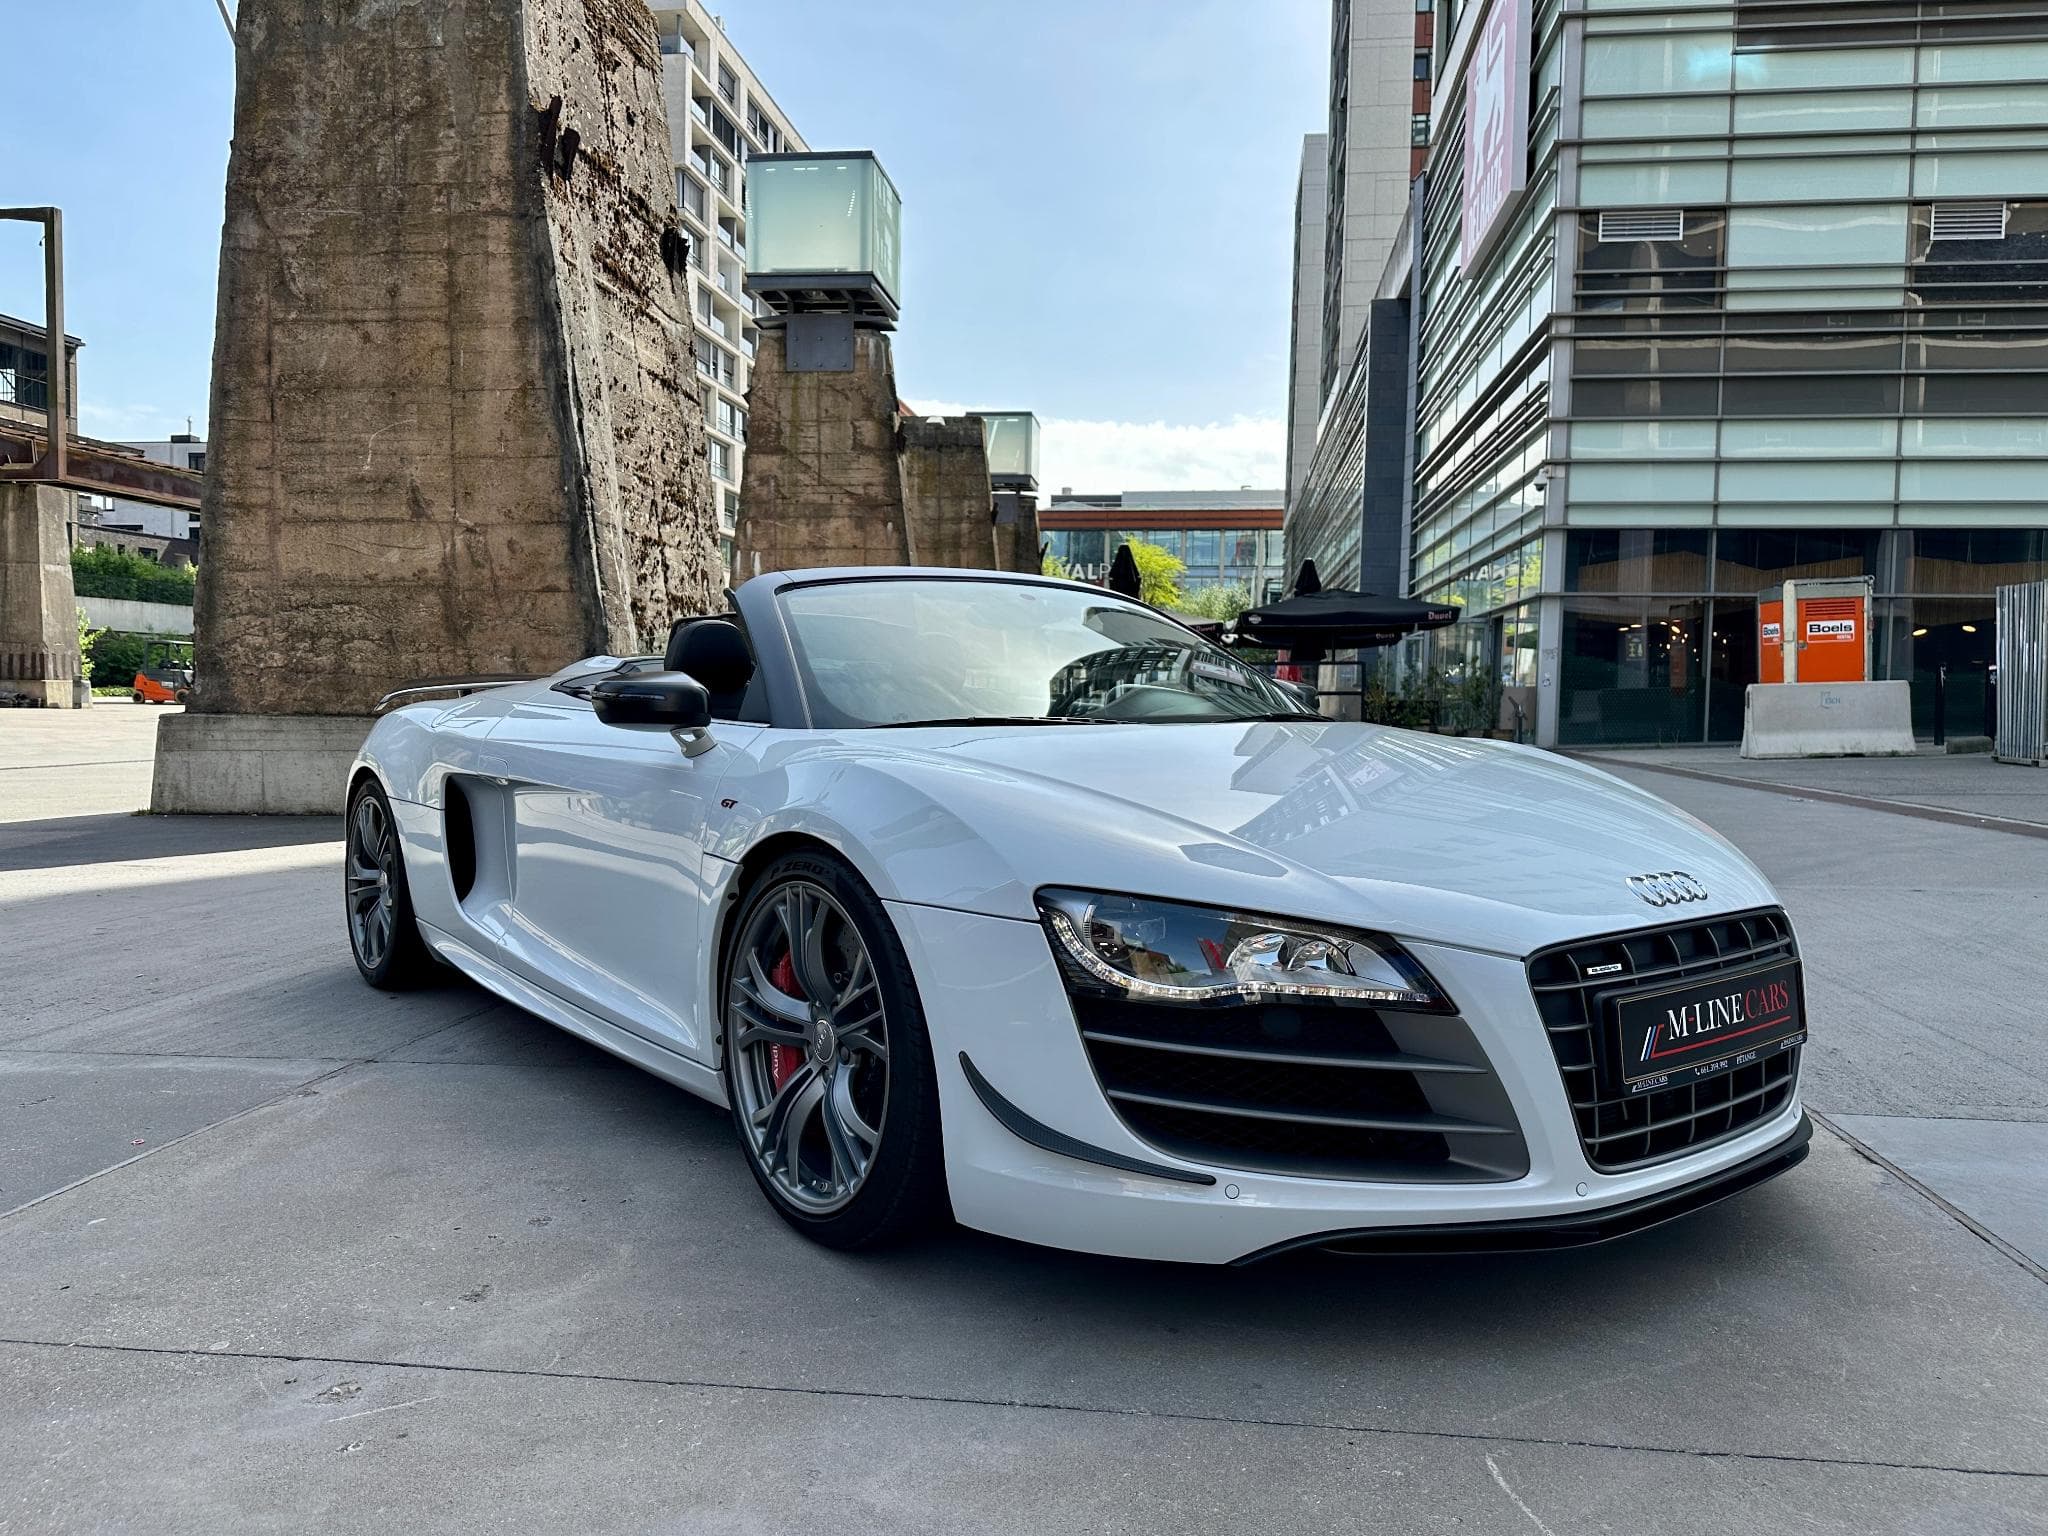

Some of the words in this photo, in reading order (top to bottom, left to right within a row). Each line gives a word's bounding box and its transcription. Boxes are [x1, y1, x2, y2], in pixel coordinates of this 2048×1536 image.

[1763, 627, 1779, 636] Boels
[1809, 622, 1852, 633] Boels
[720, 798, 739, 809] GT
